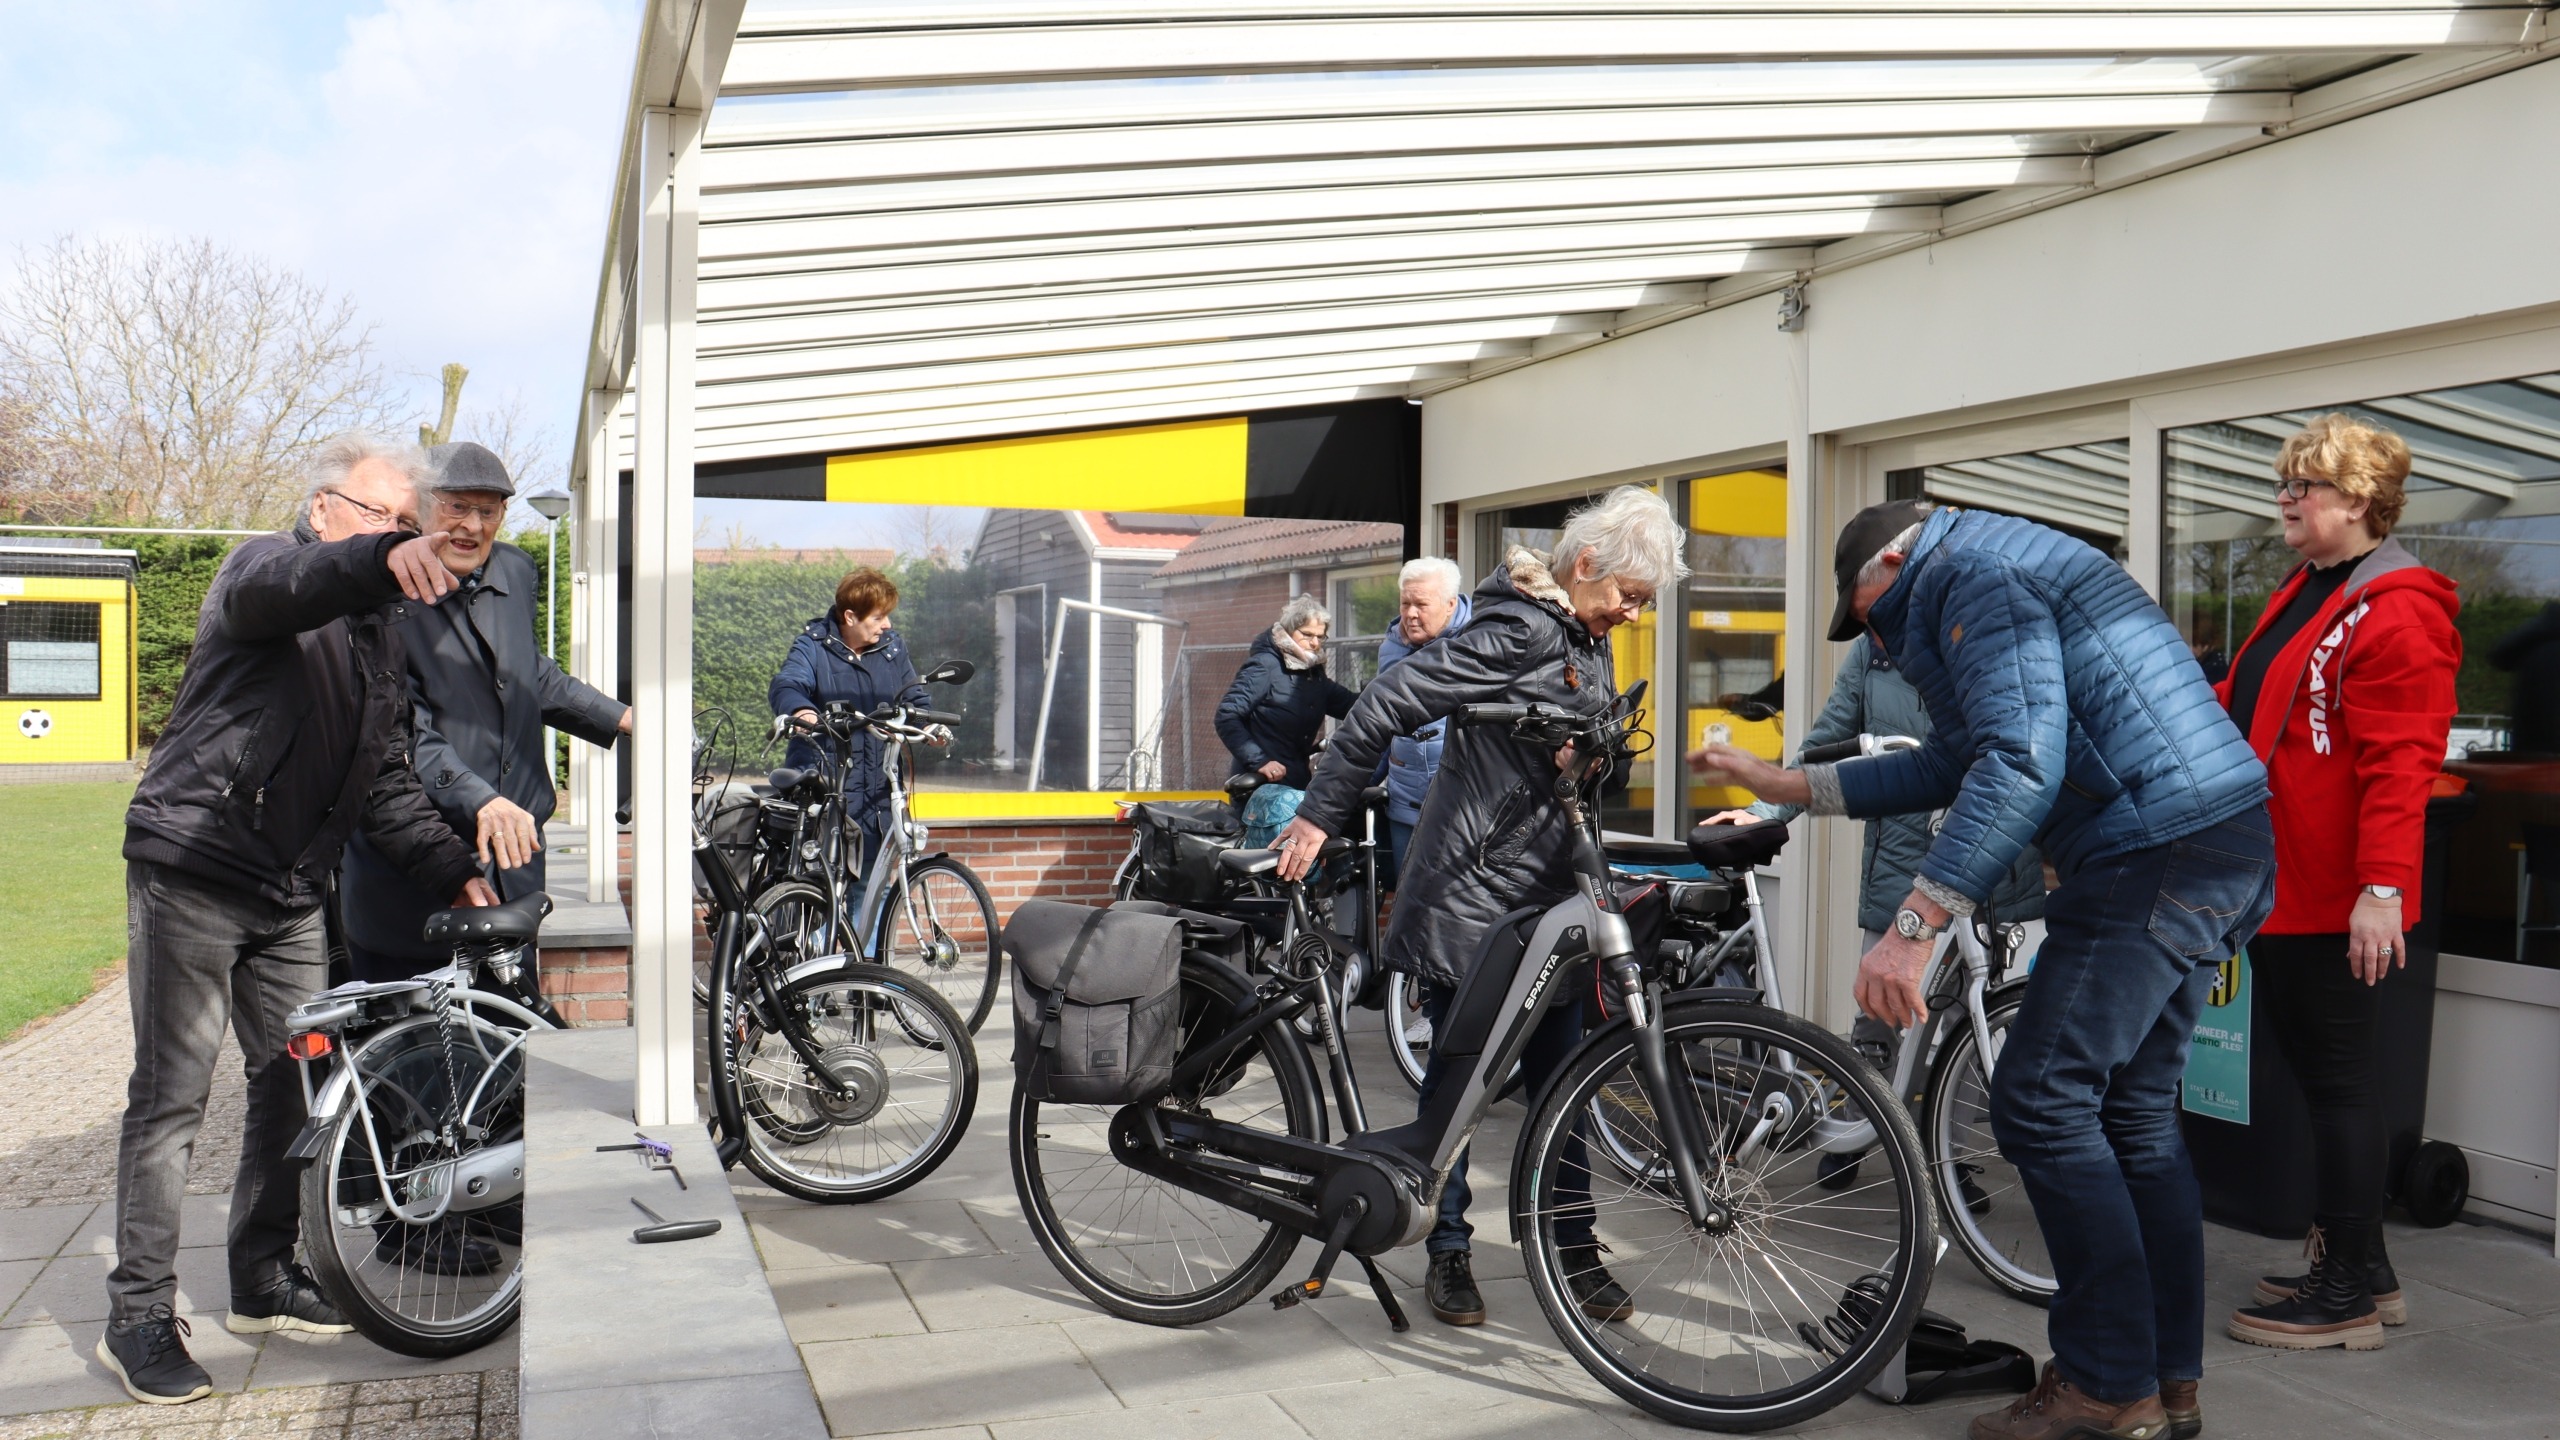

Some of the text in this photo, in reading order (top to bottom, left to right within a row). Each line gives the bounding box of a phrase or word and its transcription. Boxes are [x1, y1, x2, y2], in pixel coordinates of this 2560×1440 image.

[1524, 954, 1560, 1010] SPARTA
[1928, 965, 1947, 995] SPARTA
[2193, 1025, 2243, 1043] ONEER JE
[2193, 1035, 2243, 1052] LASTIC FLES!
